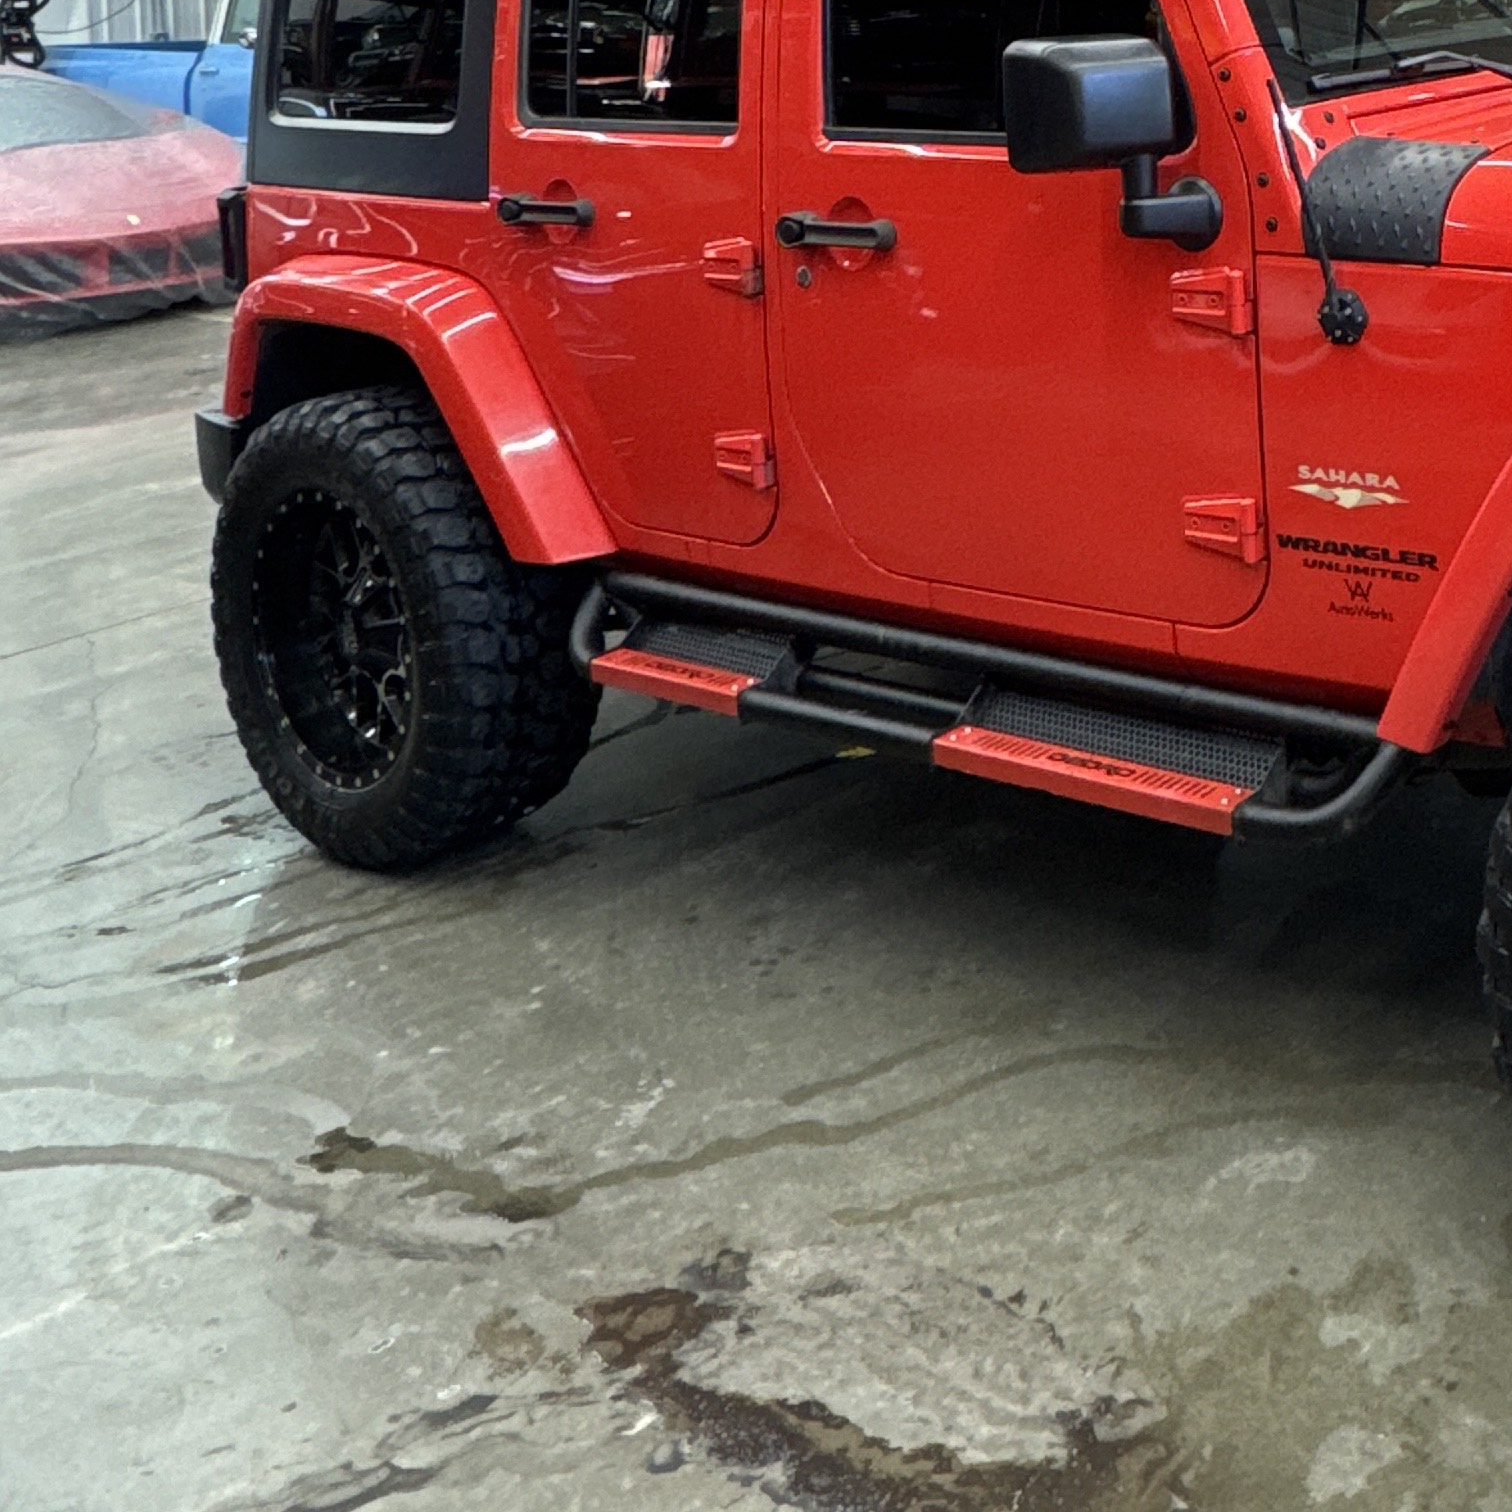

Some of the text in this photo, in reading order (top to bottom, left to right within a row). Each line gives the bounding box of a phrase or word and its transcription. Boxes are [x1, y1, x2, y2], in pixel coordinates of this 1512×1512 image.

[1297, 464, 1400, 490] SAHARA
[1275, 533, 1440, 572] WRANGLER
[1302, 557, 1421, 583] UNLIMITED
